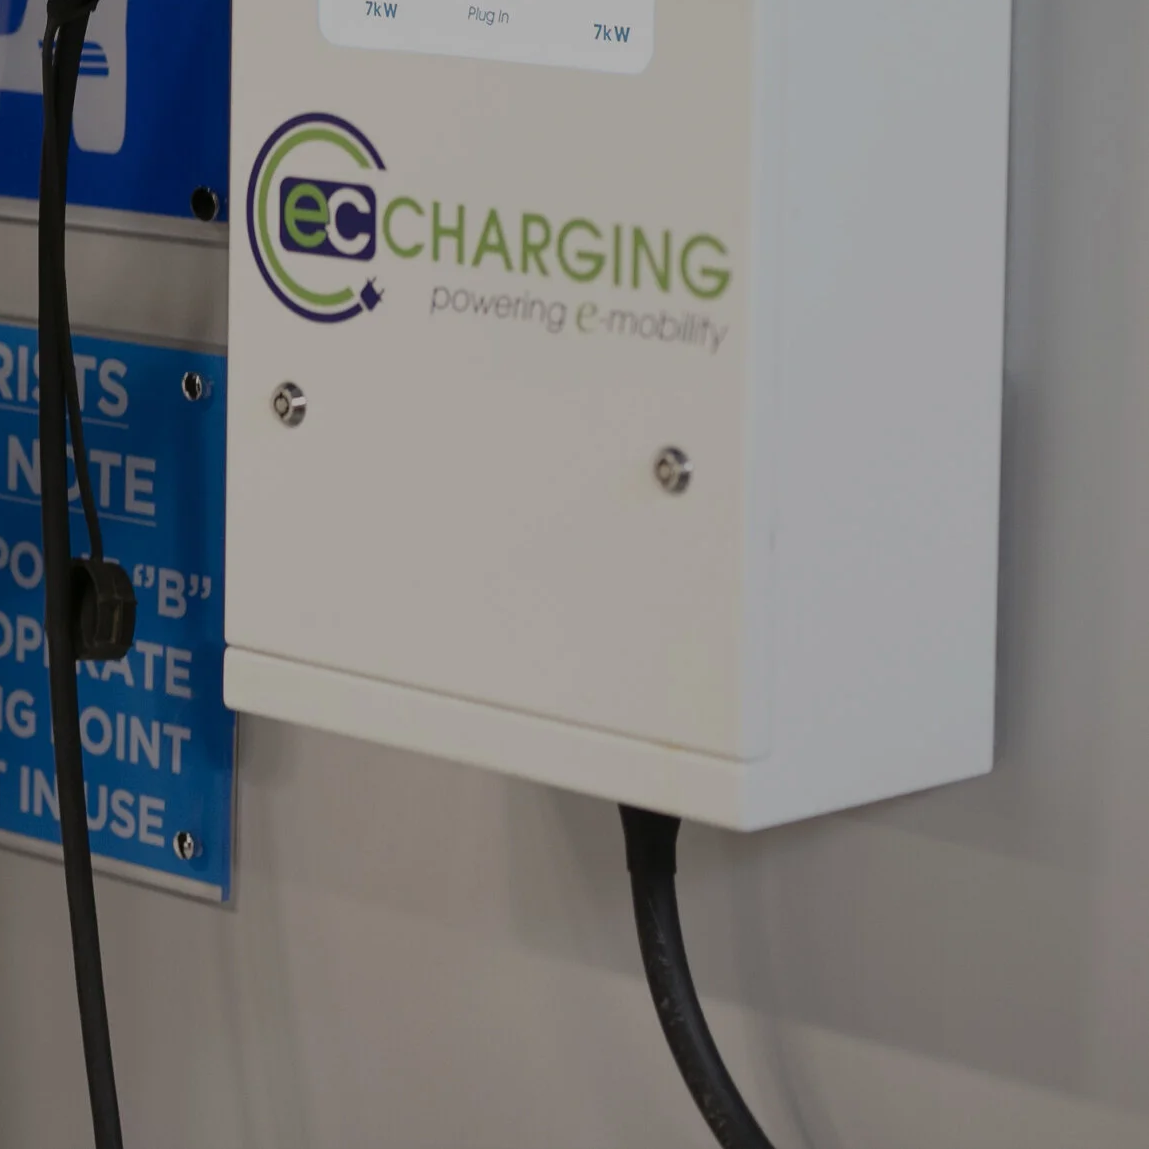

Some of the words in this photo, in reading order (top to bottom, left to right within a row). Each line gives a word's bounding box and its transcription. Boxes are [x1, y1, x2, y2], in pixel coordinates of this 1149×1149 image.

[365, 1, 398, 19] 7kW
[468, 6, 495, 25] Plug
[498, 8, 509, 24] In
[594, 24, 631, 43] 7kW
[382, 196, 733, 300] CHARGING
[430, 286, 567, 334] powering
[576, 300, 730, 355] e-mobility
[50, 706, 191, 775] OINT
[20, 765, 61, 821] IN
[84, 782, 165, 847] USE
